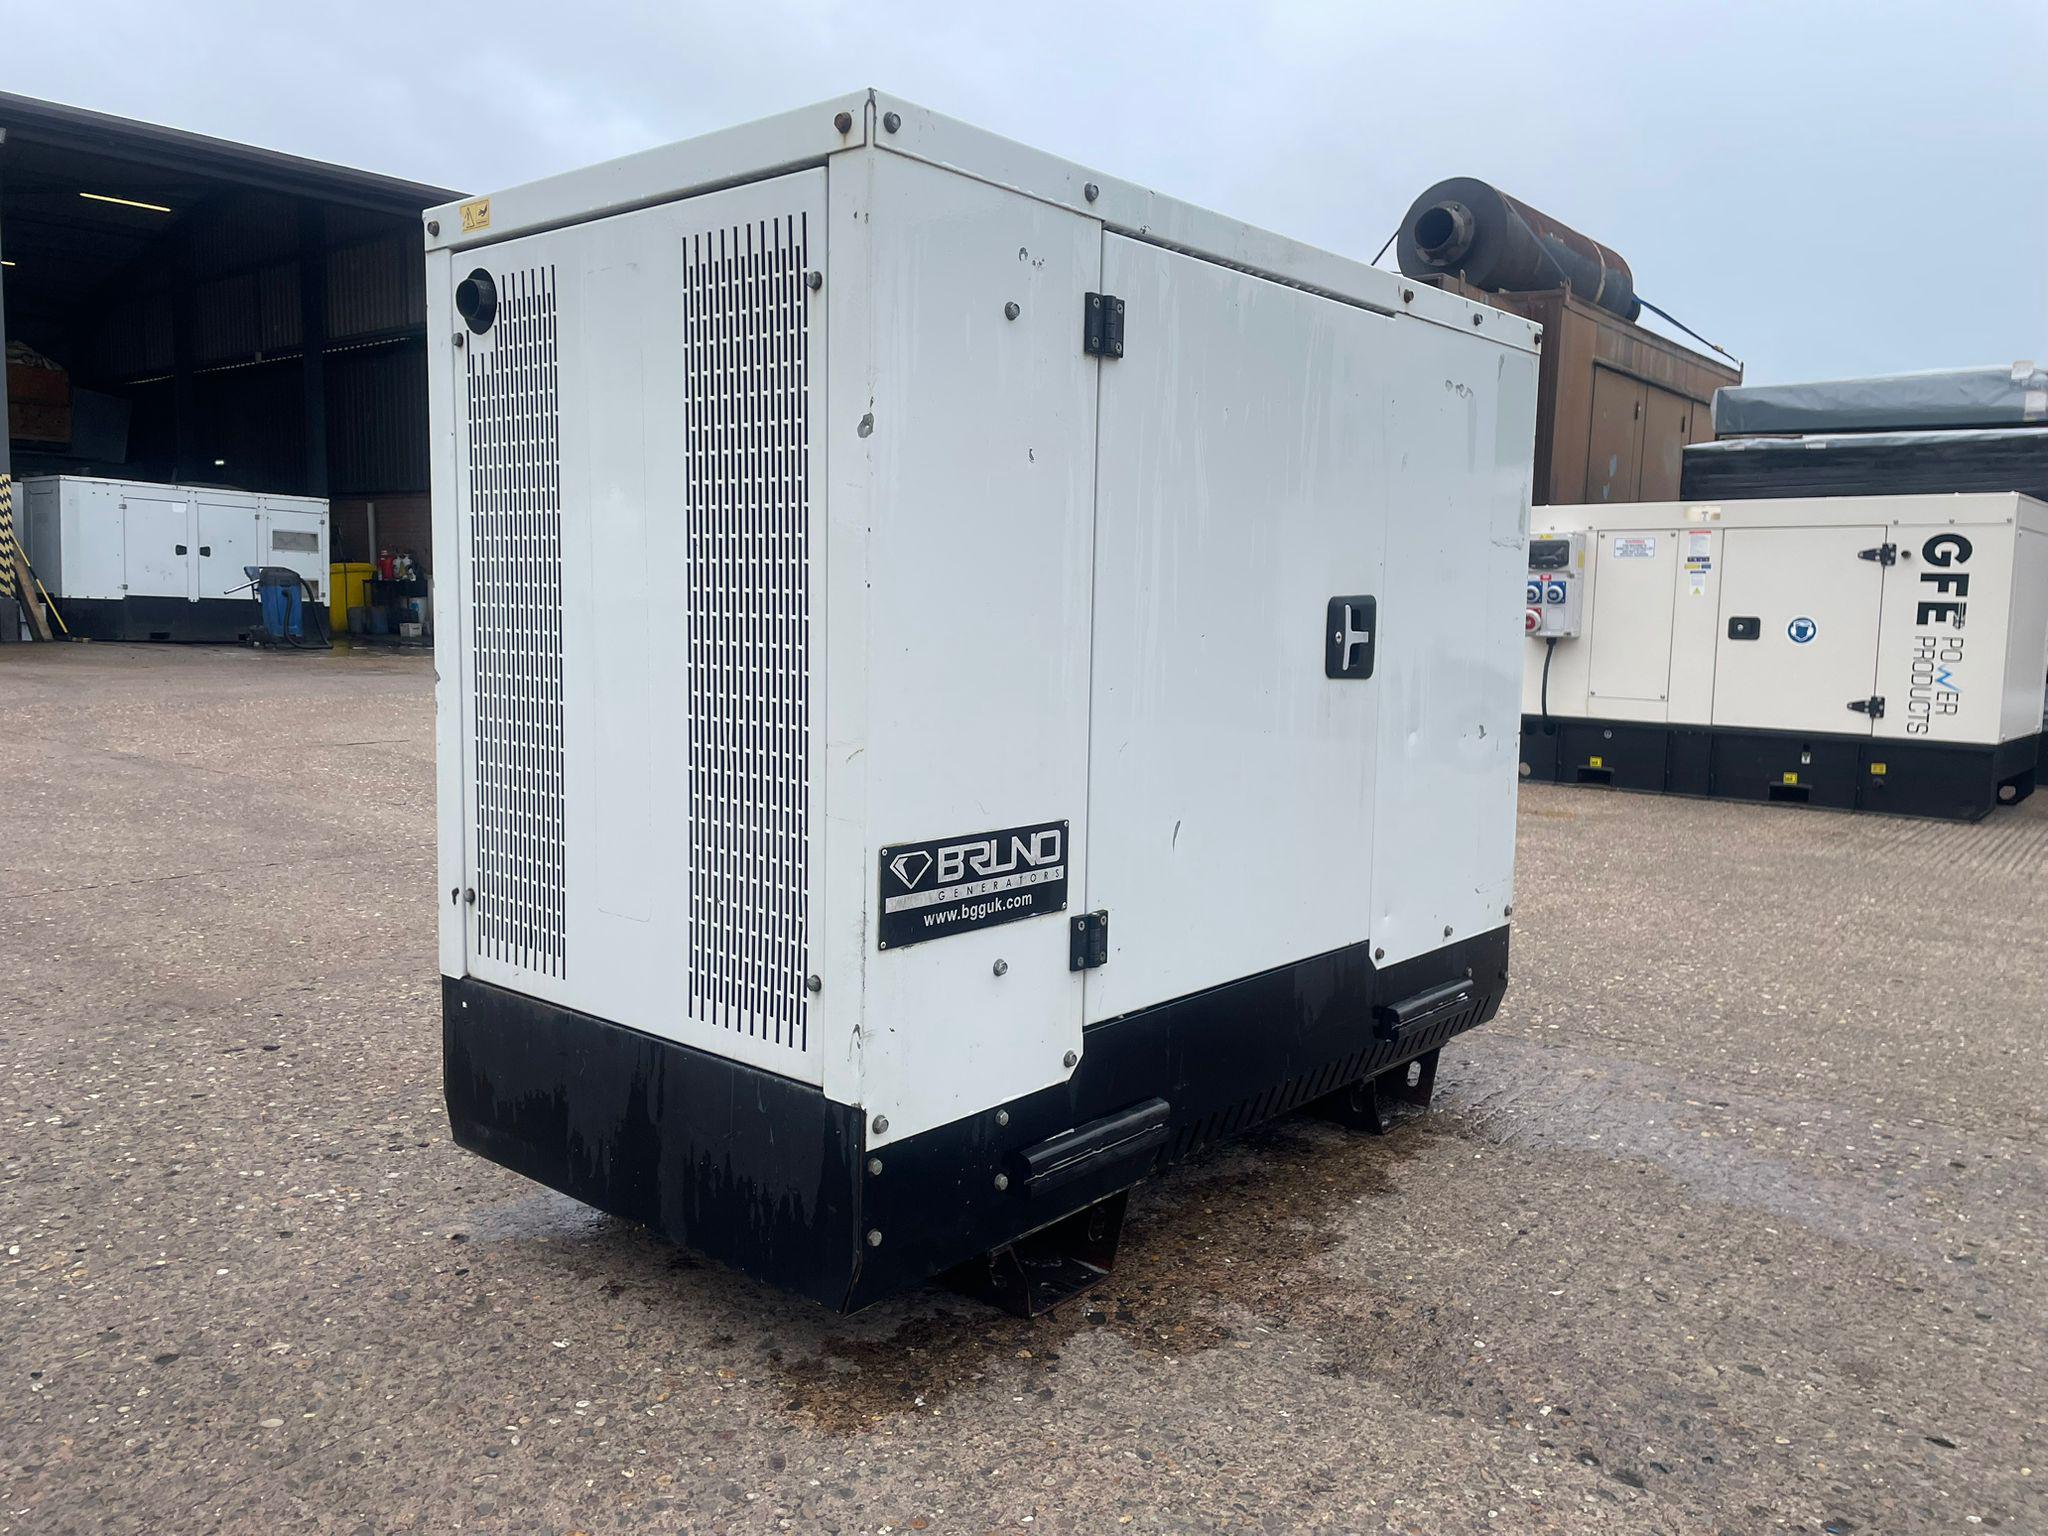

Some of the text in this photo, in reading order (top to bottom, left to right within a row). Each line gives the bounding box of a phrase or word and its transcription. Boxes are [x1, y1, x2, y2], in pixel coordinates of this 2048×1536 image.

[1916, 533, 1973, 625] GFE
[1906, 636, 1937, 735] PRODUCTS
[1935, 636, 1964, 716] POWER
[937, 829, 1061, 884] BRUNO
[937, 868, 1061, 901] GENERATORS
[923, 892, 1033, 927] www.bgguk.com
